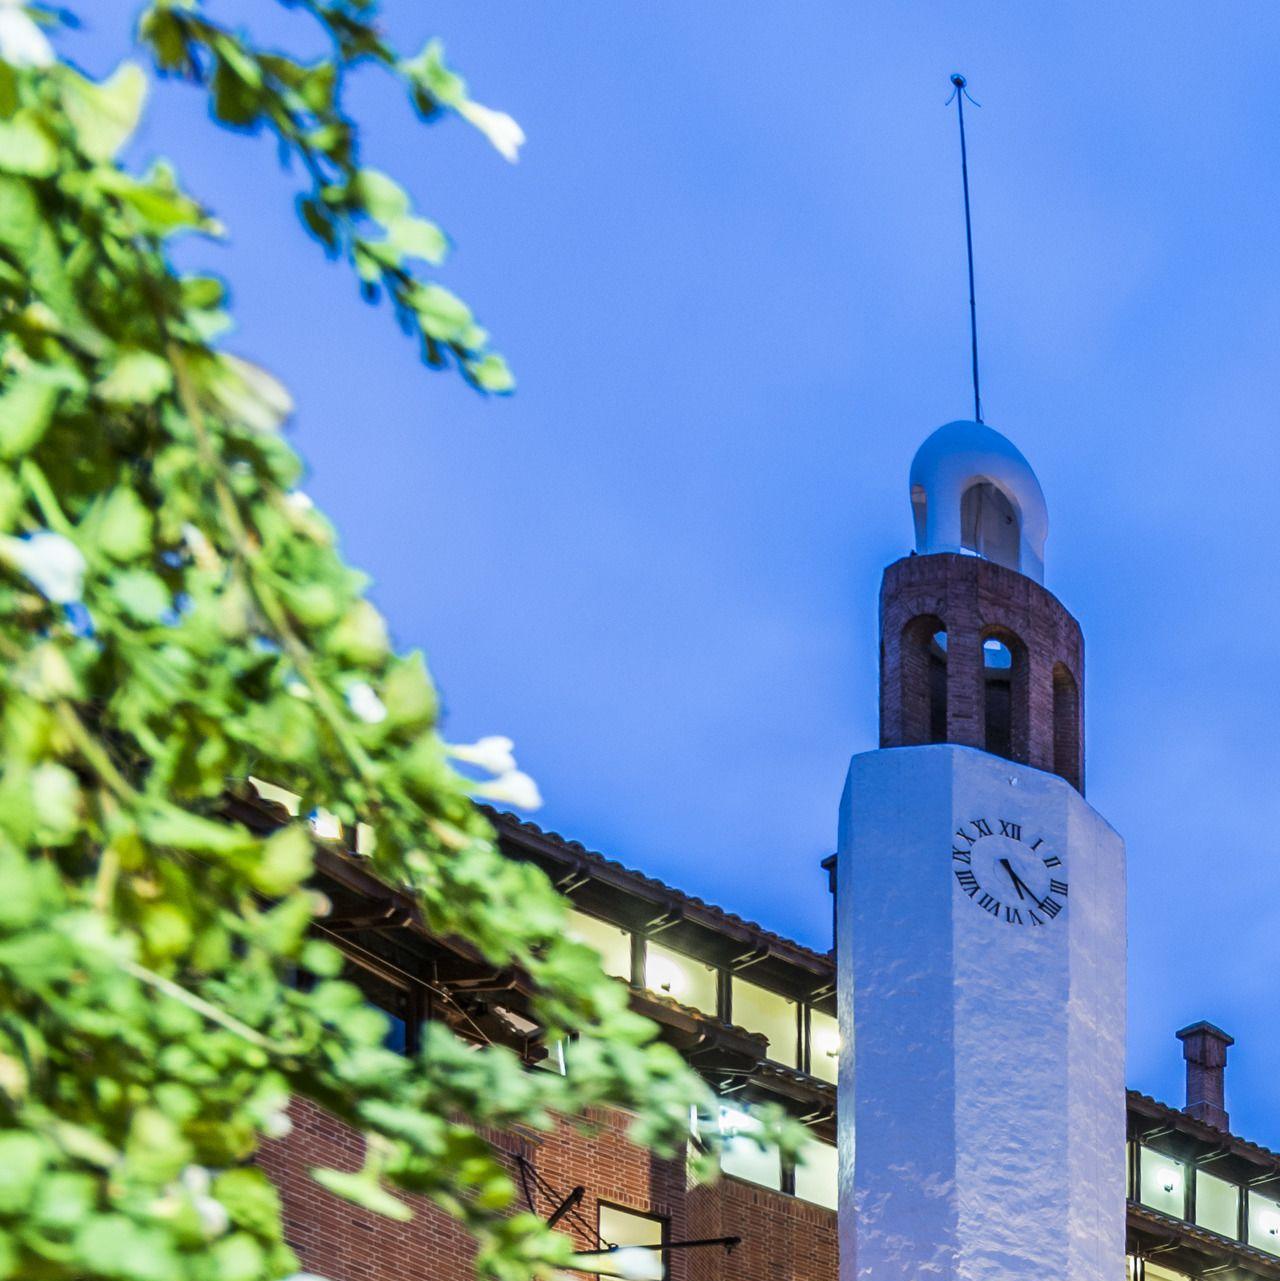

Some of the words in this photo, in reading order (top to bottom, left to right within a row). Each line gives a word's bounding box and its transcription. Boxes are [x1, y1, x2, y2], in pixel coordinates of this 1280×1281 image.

[956, 828, 977, 846] X
[970, 819, 993, 838] XI
[998, 819, 1021, 841] XII
[1030, 838, 1044, 851] I
[952, 845, 971, 865] IX
[1043, 856, 1062, 868] II
[954, 870, 981, 898] VIII
[1050, 878, 1069, 897] III
[978, 893, 1002, 917] VII
[1005, 906, 1024, 925] VI
[1028, 909, 1044, 926] V
